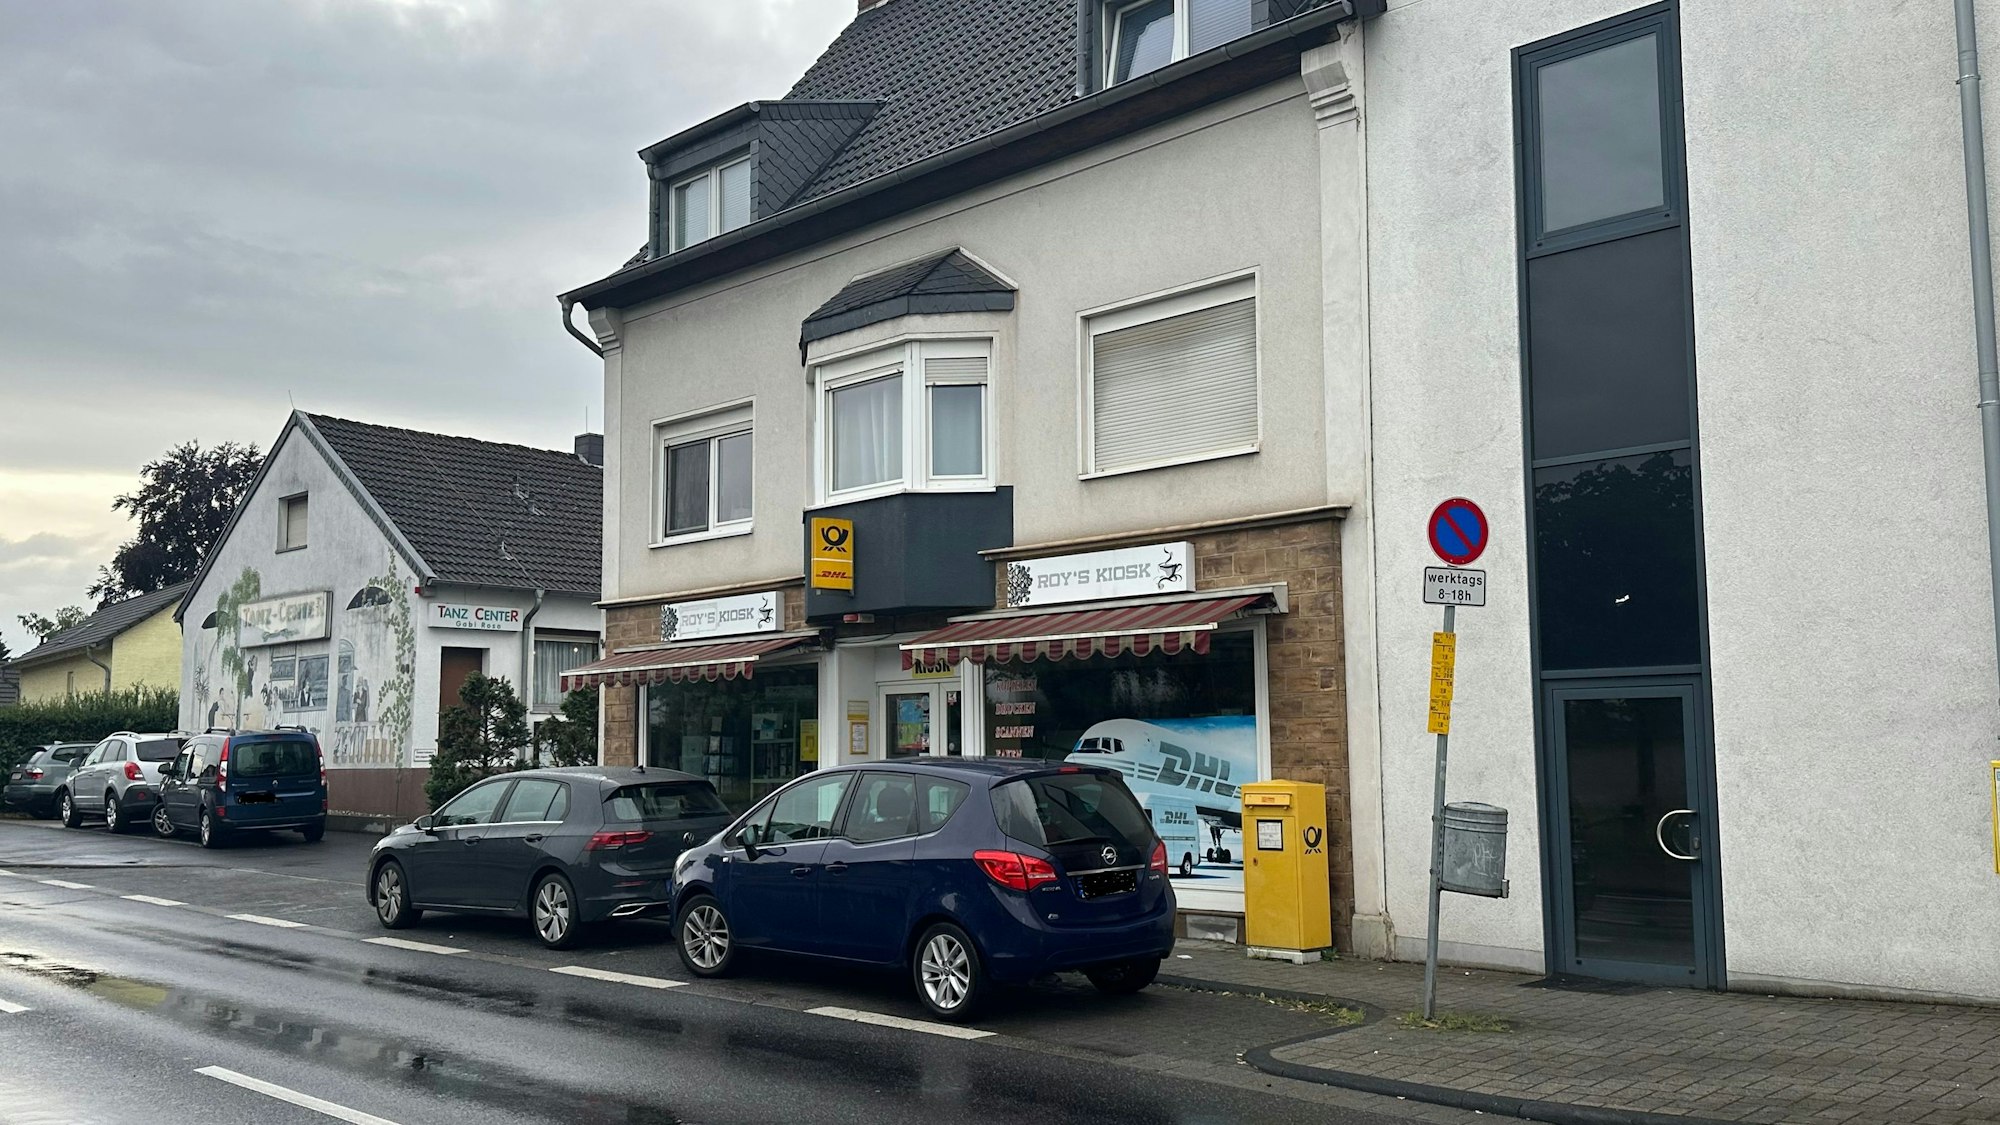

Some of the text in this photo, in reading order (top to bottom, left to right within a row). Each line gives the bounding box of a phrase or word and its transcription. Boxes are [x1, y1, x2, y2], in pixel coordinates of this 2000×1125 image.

[819, 570, 849, 579] DHL
[1037, 562, 1151, 589] ROY'S KIOSK
[1428, 573, 1483, 587] werktags
[1438, 588, 1472, 601] 8-18h
[437, 605, 519, 622] TANZ CENTER
[681, 607, 755, 627] ROY'S KIOSK
[1156, 740, 1238, 798] DHL
[1162, 810, 1192, 825] DHL
